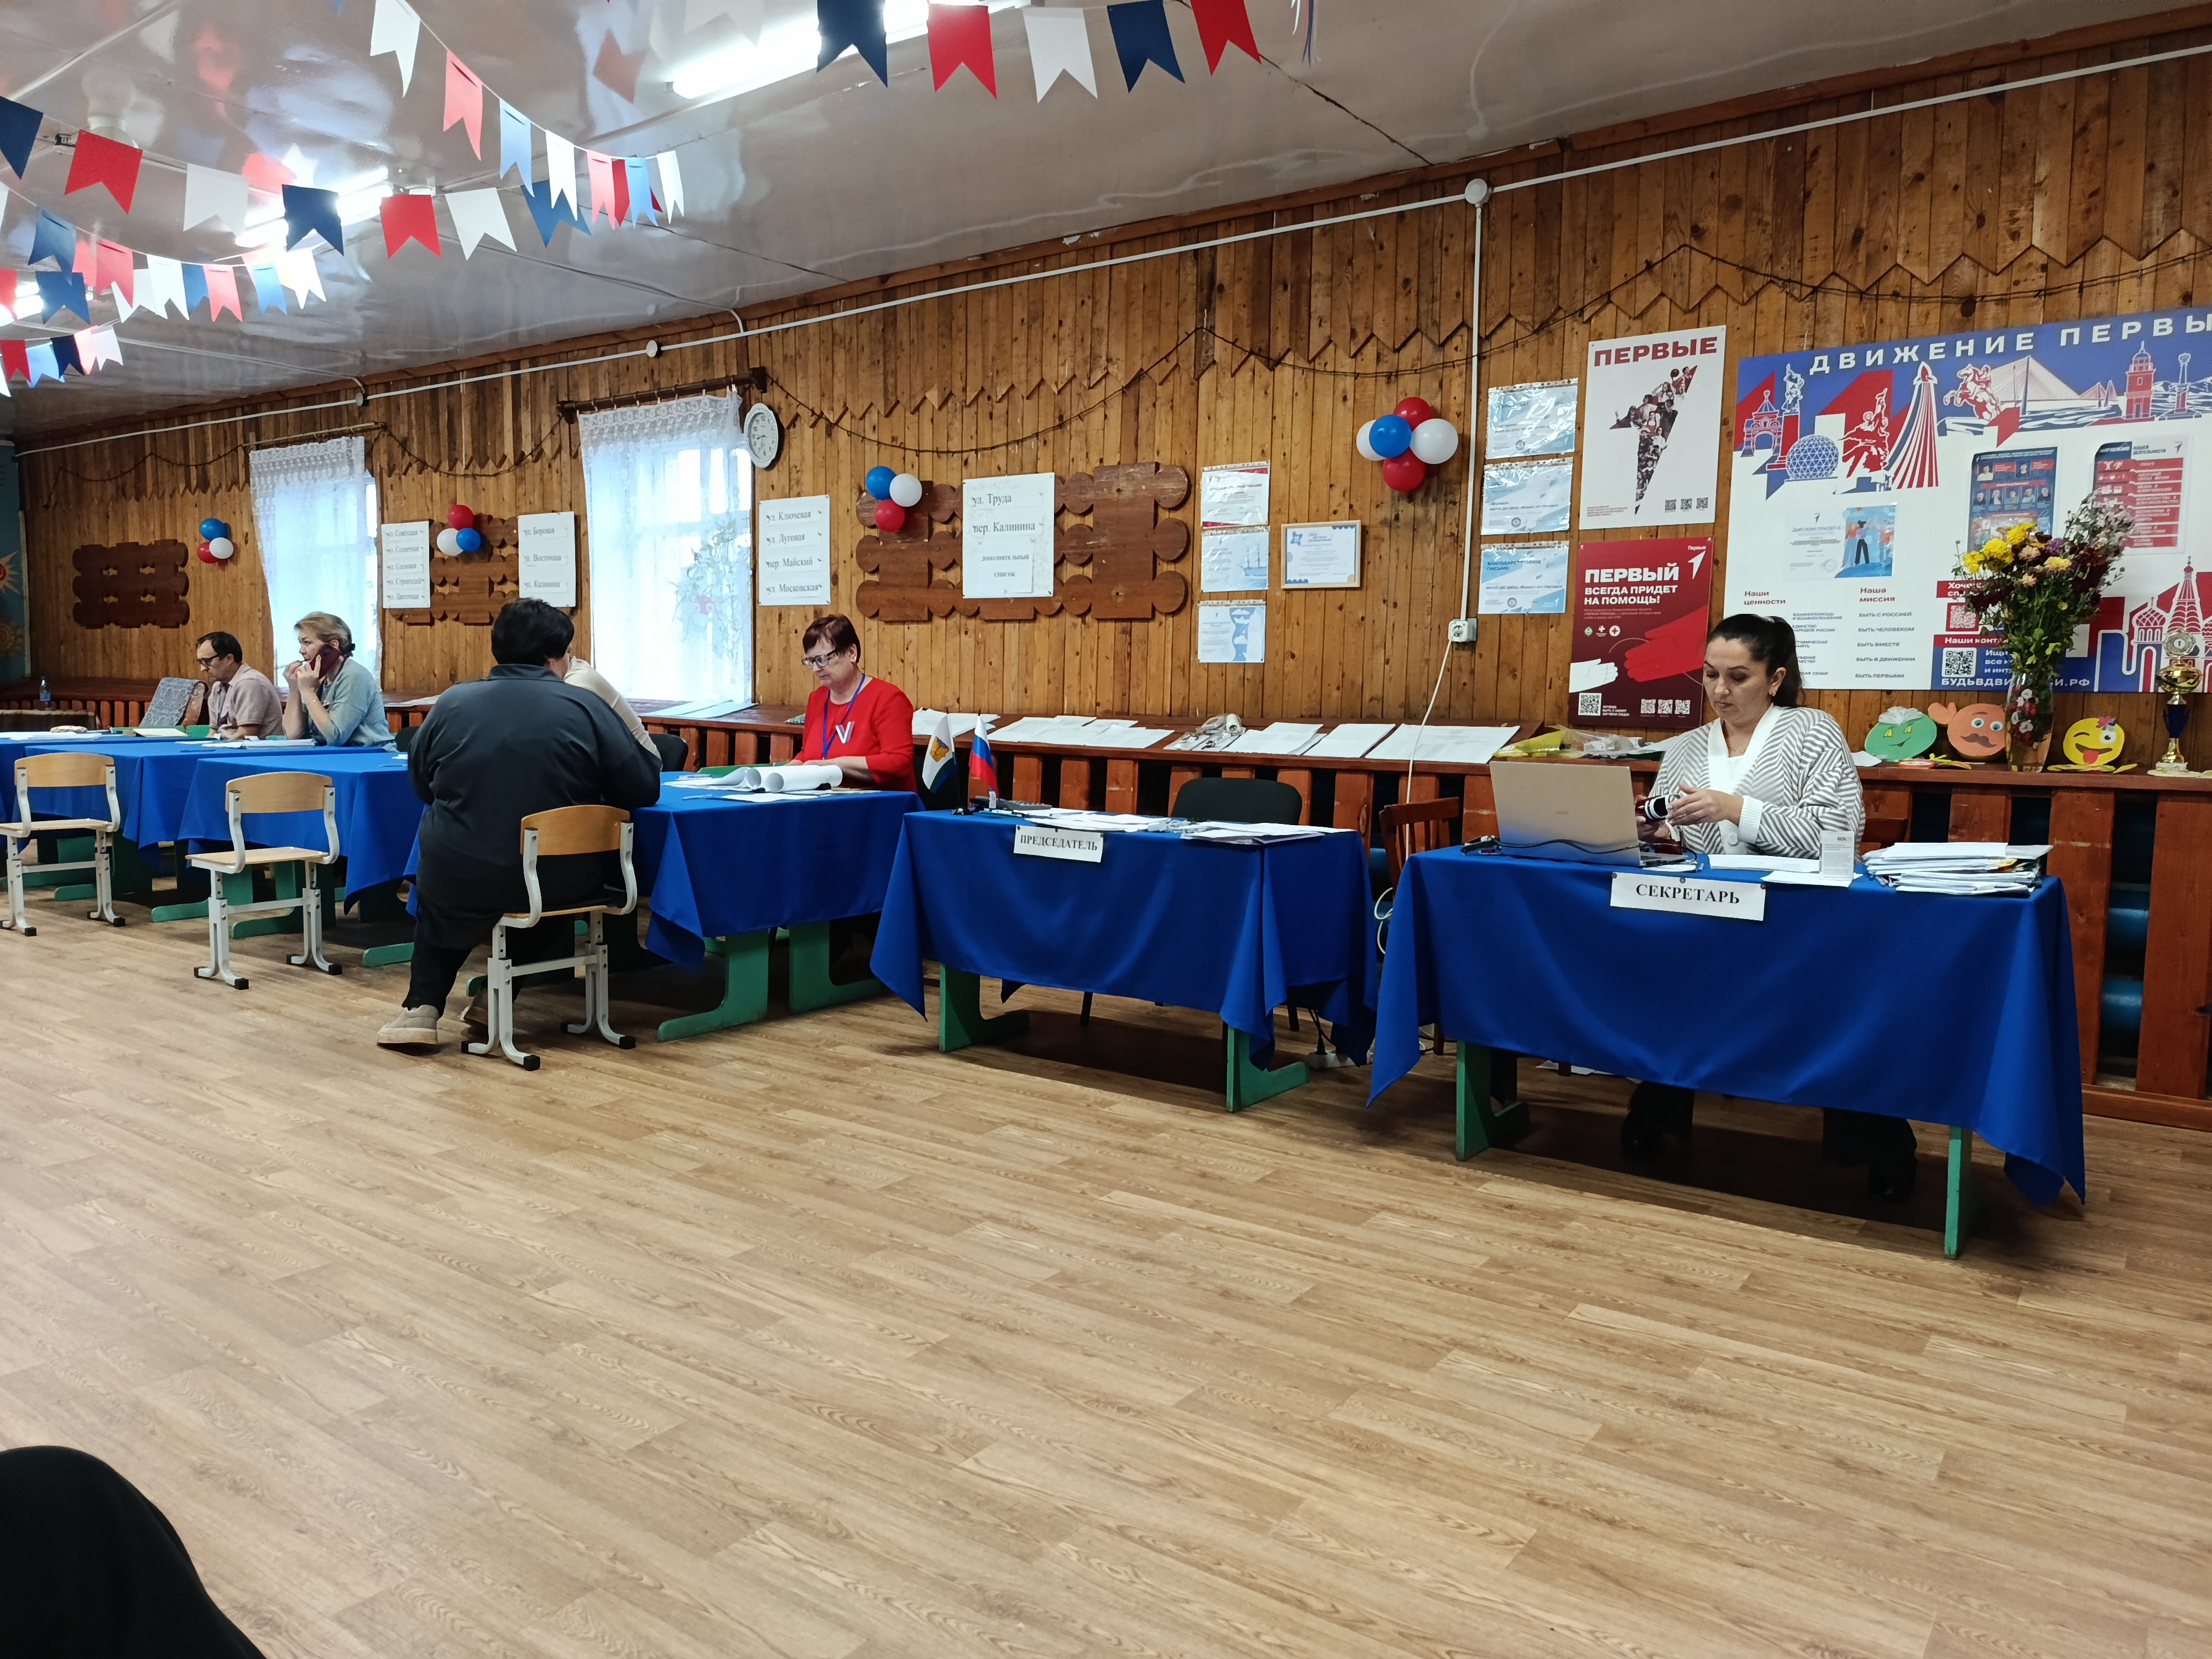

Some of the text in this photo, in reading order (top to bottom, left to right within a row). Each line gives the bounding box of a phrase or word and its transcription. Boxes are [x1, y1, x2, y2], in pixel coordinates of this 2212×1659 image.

[1594, 336, 1718, 367] ПЕРВЫЕ
[1809, 332, 2034, 375] ДВИЖЕНИЕ
[987, 493, 1012, 506] Труда
[778, 511, 811, 521] Ключевая
[993, 521, 1035, 533] Калинина
[779, 534, 805, 545] Луговая
[533, 554, 561, 562] Восточная
[782, 557, 813, 567] Майский
[981, 554, 1029, 562] дополнительный
[1585, 562, 1679, 583] ПЕРВЫЙ
[779, 584, 818, 593] Московская
[1584, 585, 1678, 596] ВСЕГДА ПРИДЕТ
[1601, 596, 1660, 604] ПОМОЩЬ!
[1020, 834, 1098, 851] ПРЕДСЕДАТЕЛЬ
[1636, 884, 1740, 904] СЕКРЕТАРЬ
